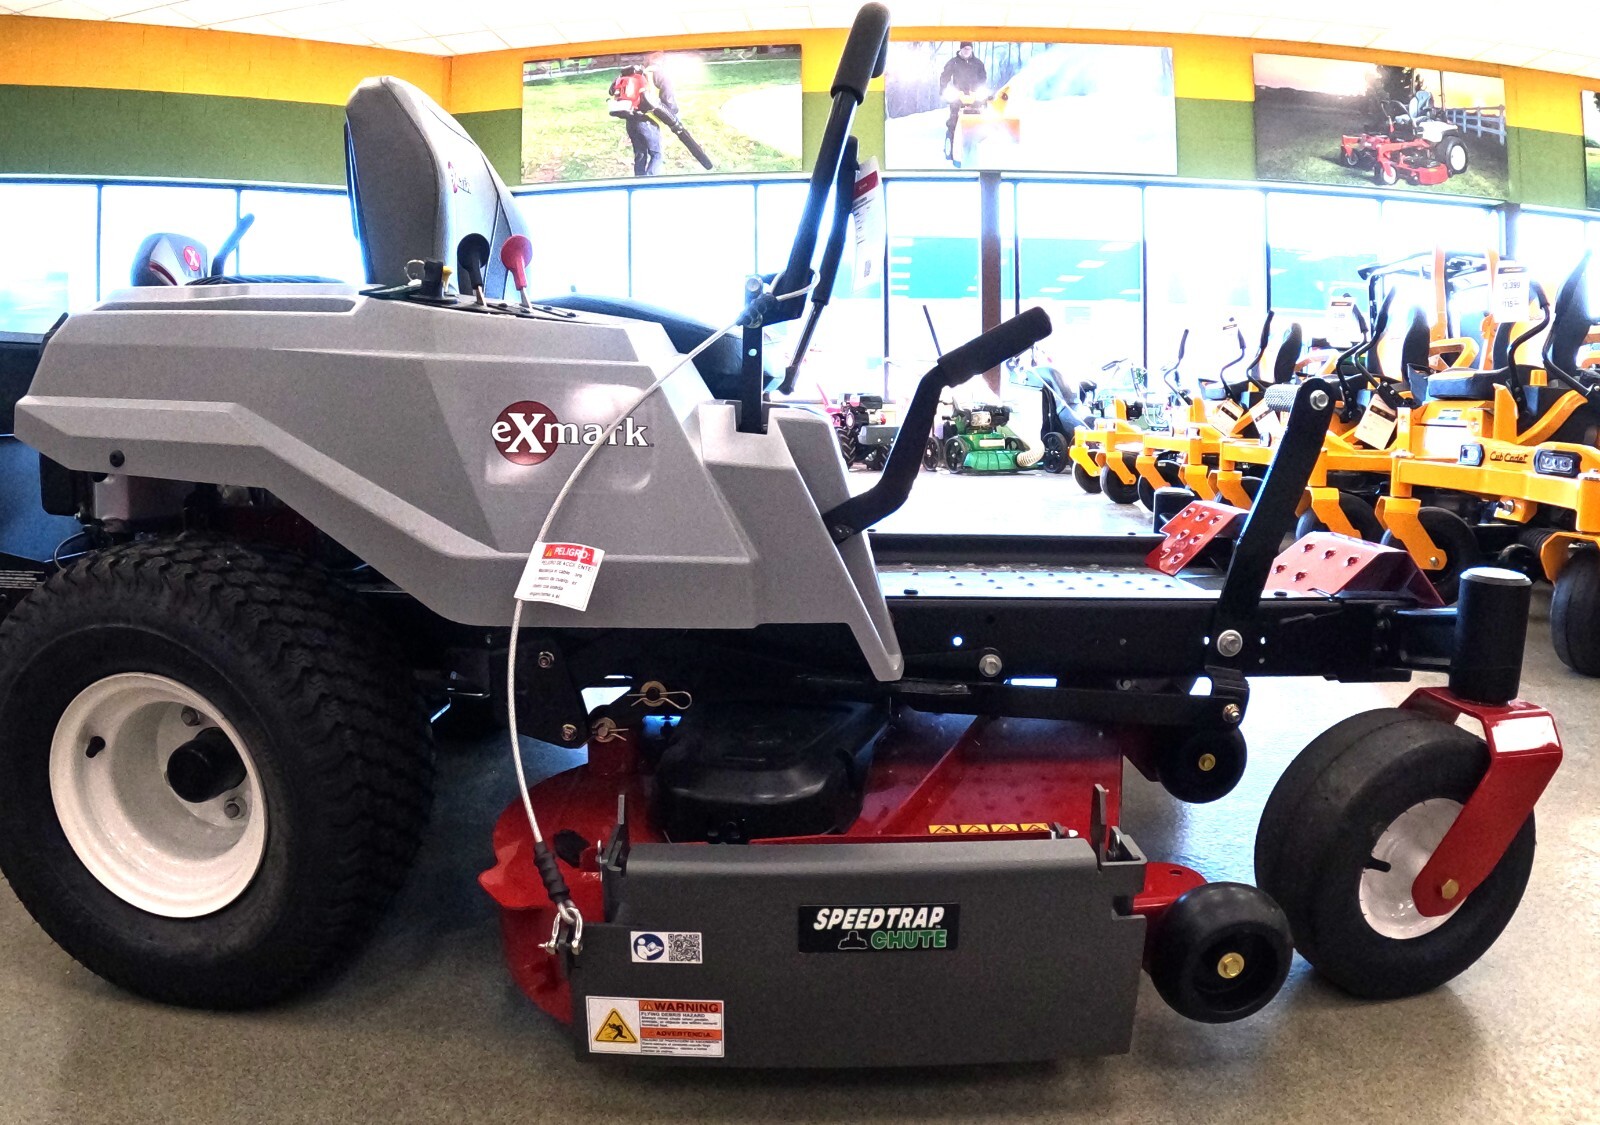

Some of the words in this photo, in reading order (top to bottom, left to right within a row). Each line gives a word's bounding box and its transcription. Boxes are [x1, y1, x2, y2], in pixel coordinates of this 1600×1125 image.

[1490, 451, 1503, 461] Cub
[1504, 453, 1528, 464] Cadet
[813, 906, 945, 930] SPEEDTRAP
[871, 930, 948, 950] CHUTE
[654, 1002, 719, 1013] WARNING
